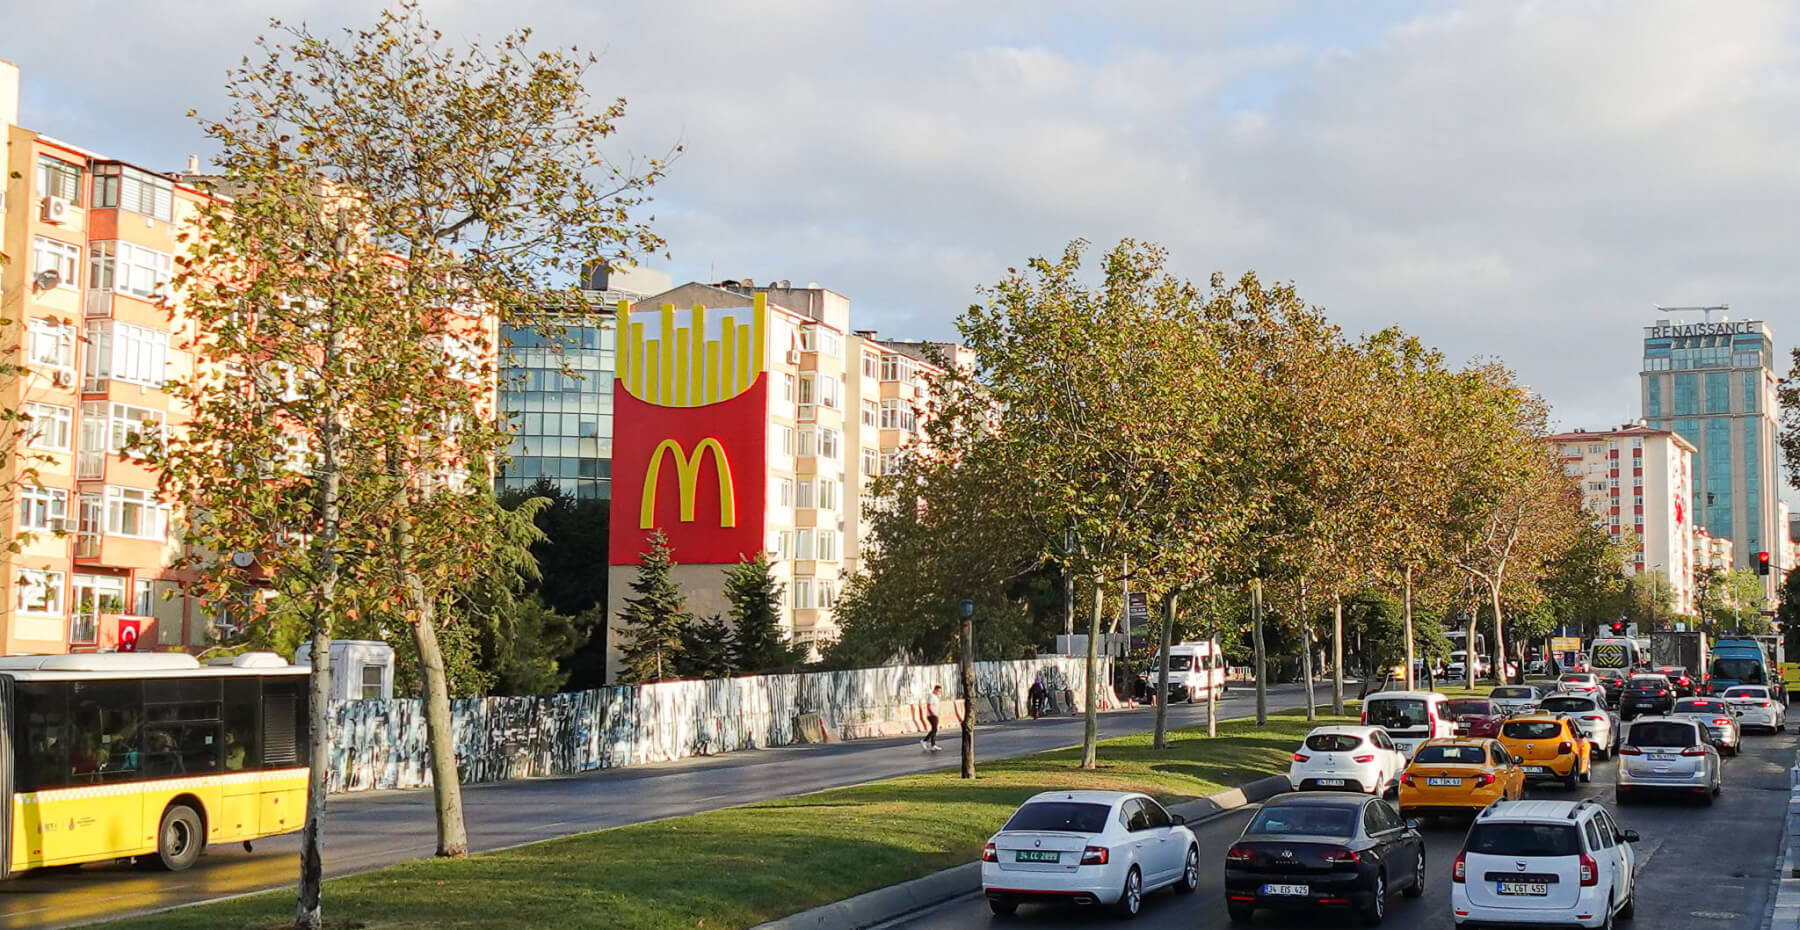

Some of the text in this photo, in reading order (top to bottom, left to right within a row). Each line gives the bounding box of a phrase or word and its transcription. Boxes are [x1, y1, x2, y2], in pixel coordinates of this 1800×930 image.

[1652, 322, 1754, 338] RENAISSANCE
[1268, 885, 1277, 894] 34
[1502, 883, 1546, 893] 34 CGT 455
